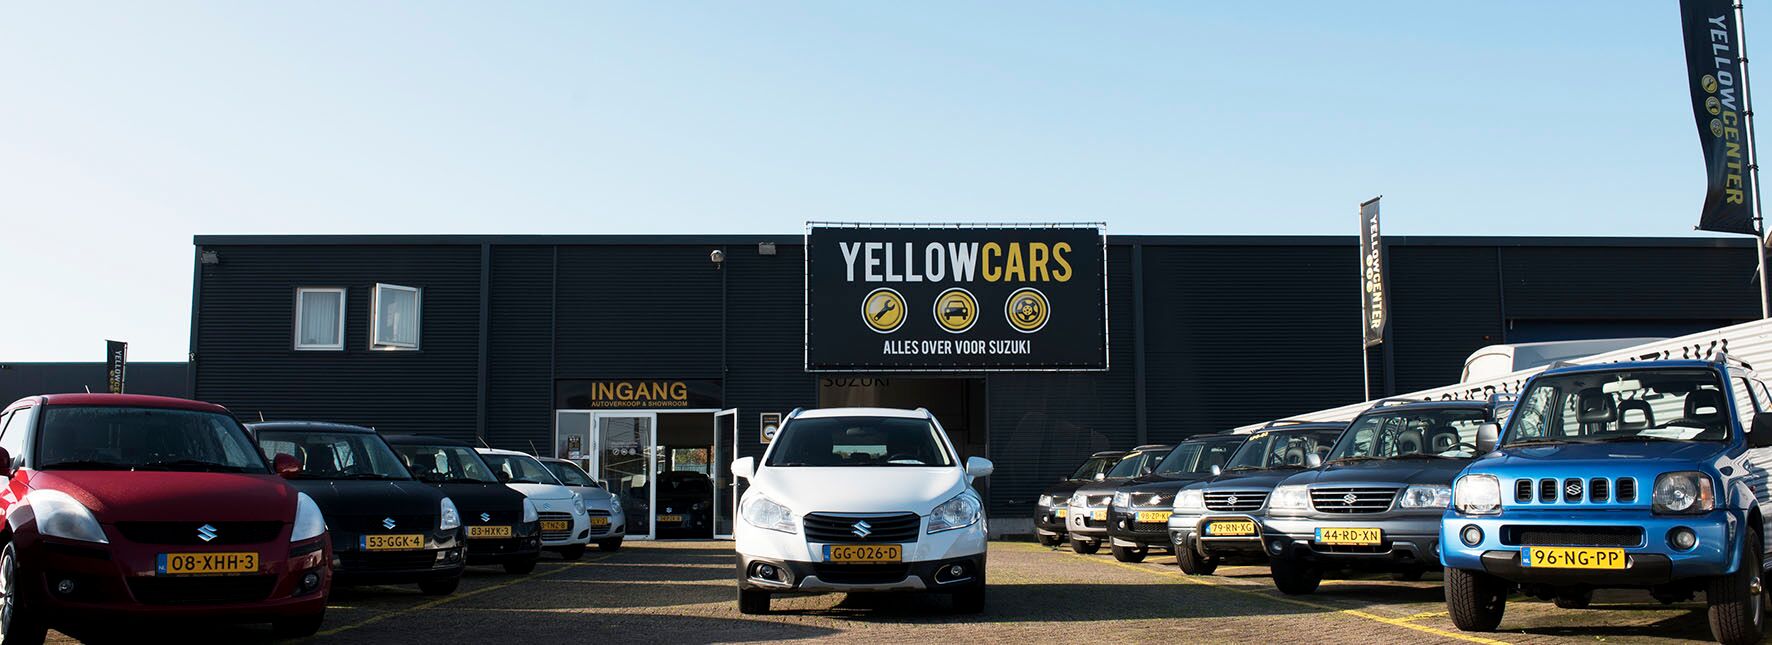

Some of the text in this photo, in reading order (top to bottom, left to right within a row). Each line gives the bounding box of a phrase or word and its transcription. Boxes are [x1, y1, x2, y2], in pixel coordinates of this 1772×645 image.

[1708, 15, 1743, 204] YELLOWCENTER
[839, 242, 1073, 283] YELLOWCARS
[1370, 214, 1382, 329] YELLOWCENTER
[883, 340, 1031, 354] ALLES OVER VOOR SUZUKI
[591, 382, 688, 401] INGANG
[471, 527, 509, 536] 83-HXK-3
[1212, 523, 1252, 532] 79-RN-XG
[369, 535, 420, 548] 53-GGK-4
[1324, 530, 1378, 541] 44-RD-XN
[833, 547, 897, 559] GG-026-D
[1535, 550, 1619, 566] 96-NG-PP
[172, 555, 254, 571] 08-XHH-3
